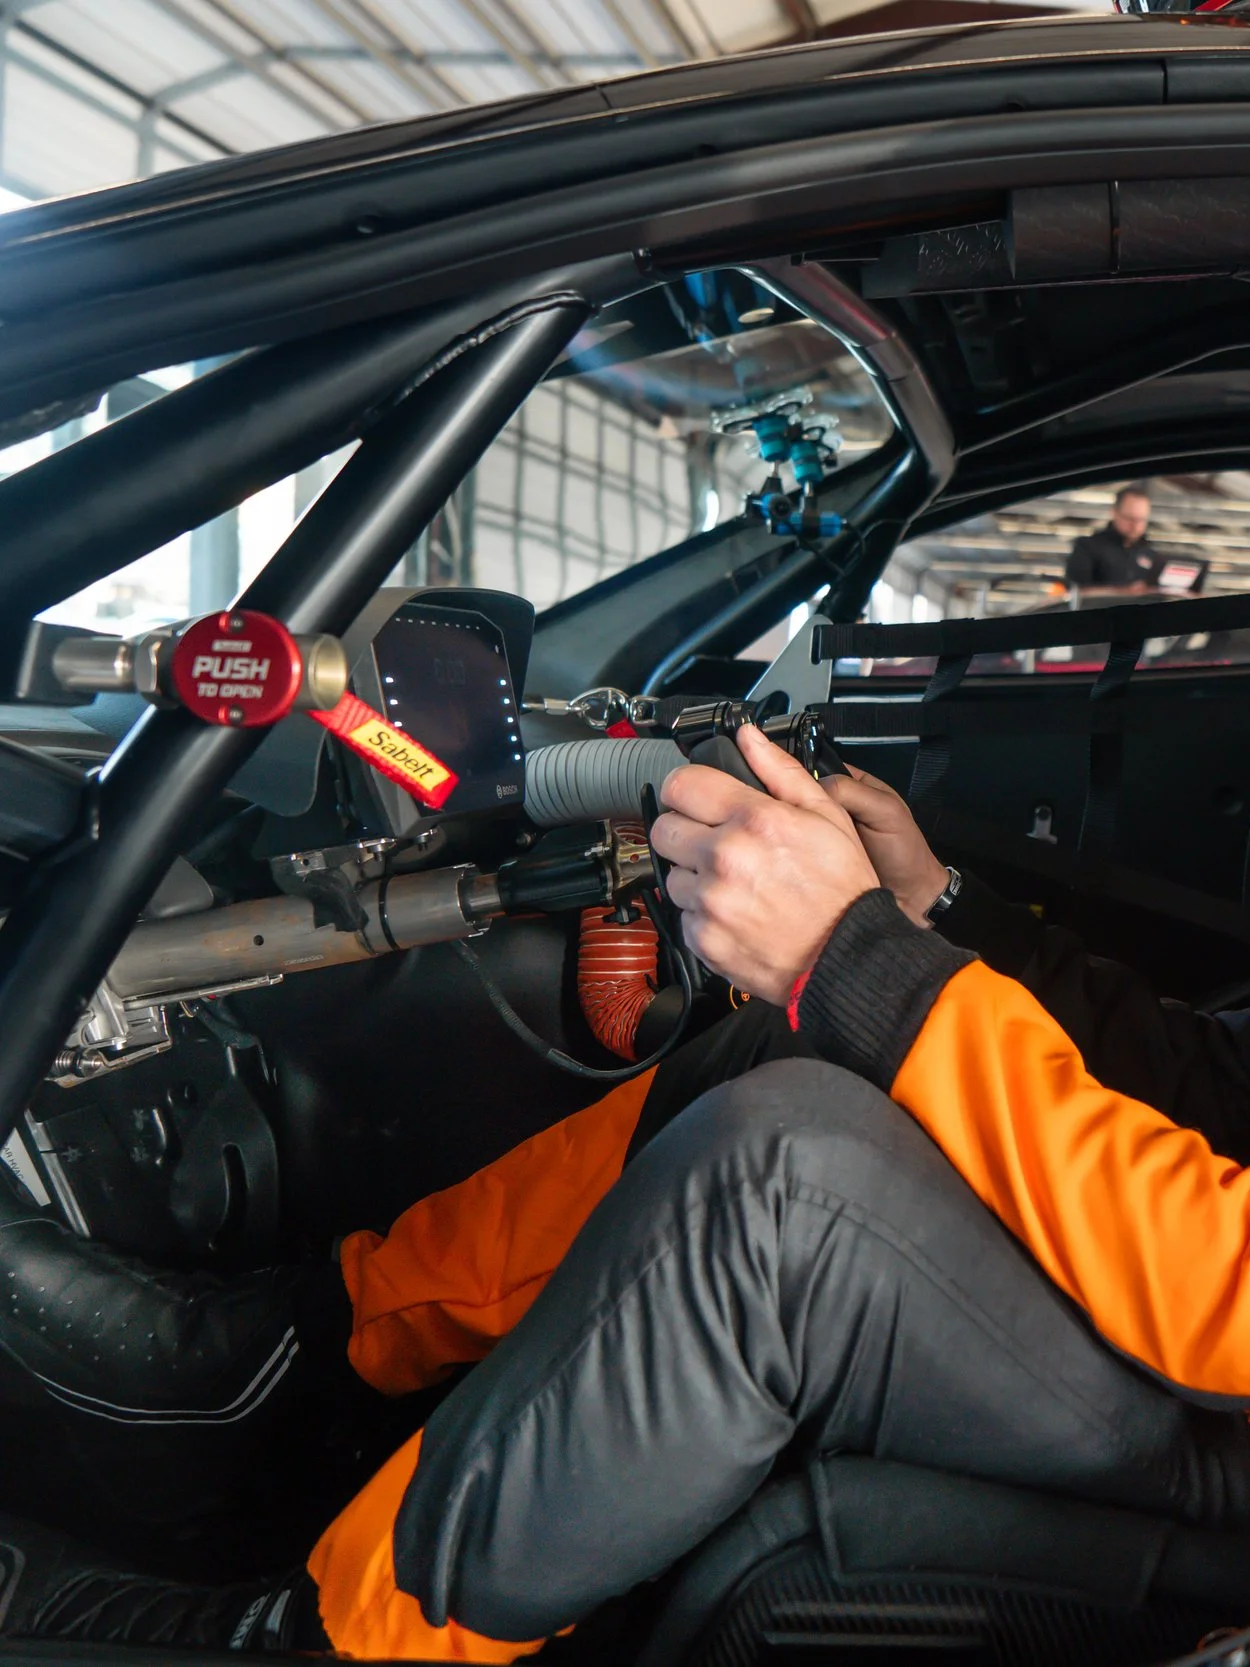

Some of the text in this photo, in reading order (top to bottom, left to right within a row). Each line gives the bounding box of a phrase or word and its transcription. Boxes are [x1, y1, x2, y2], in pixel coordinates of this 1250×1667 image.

[191, 655, 271, 681] PUSH
[197, 682, 264, 699] TO OPEN
[368, 730, 435, 780] Sabelt
[502, 785, 518, 796] BOSCH
